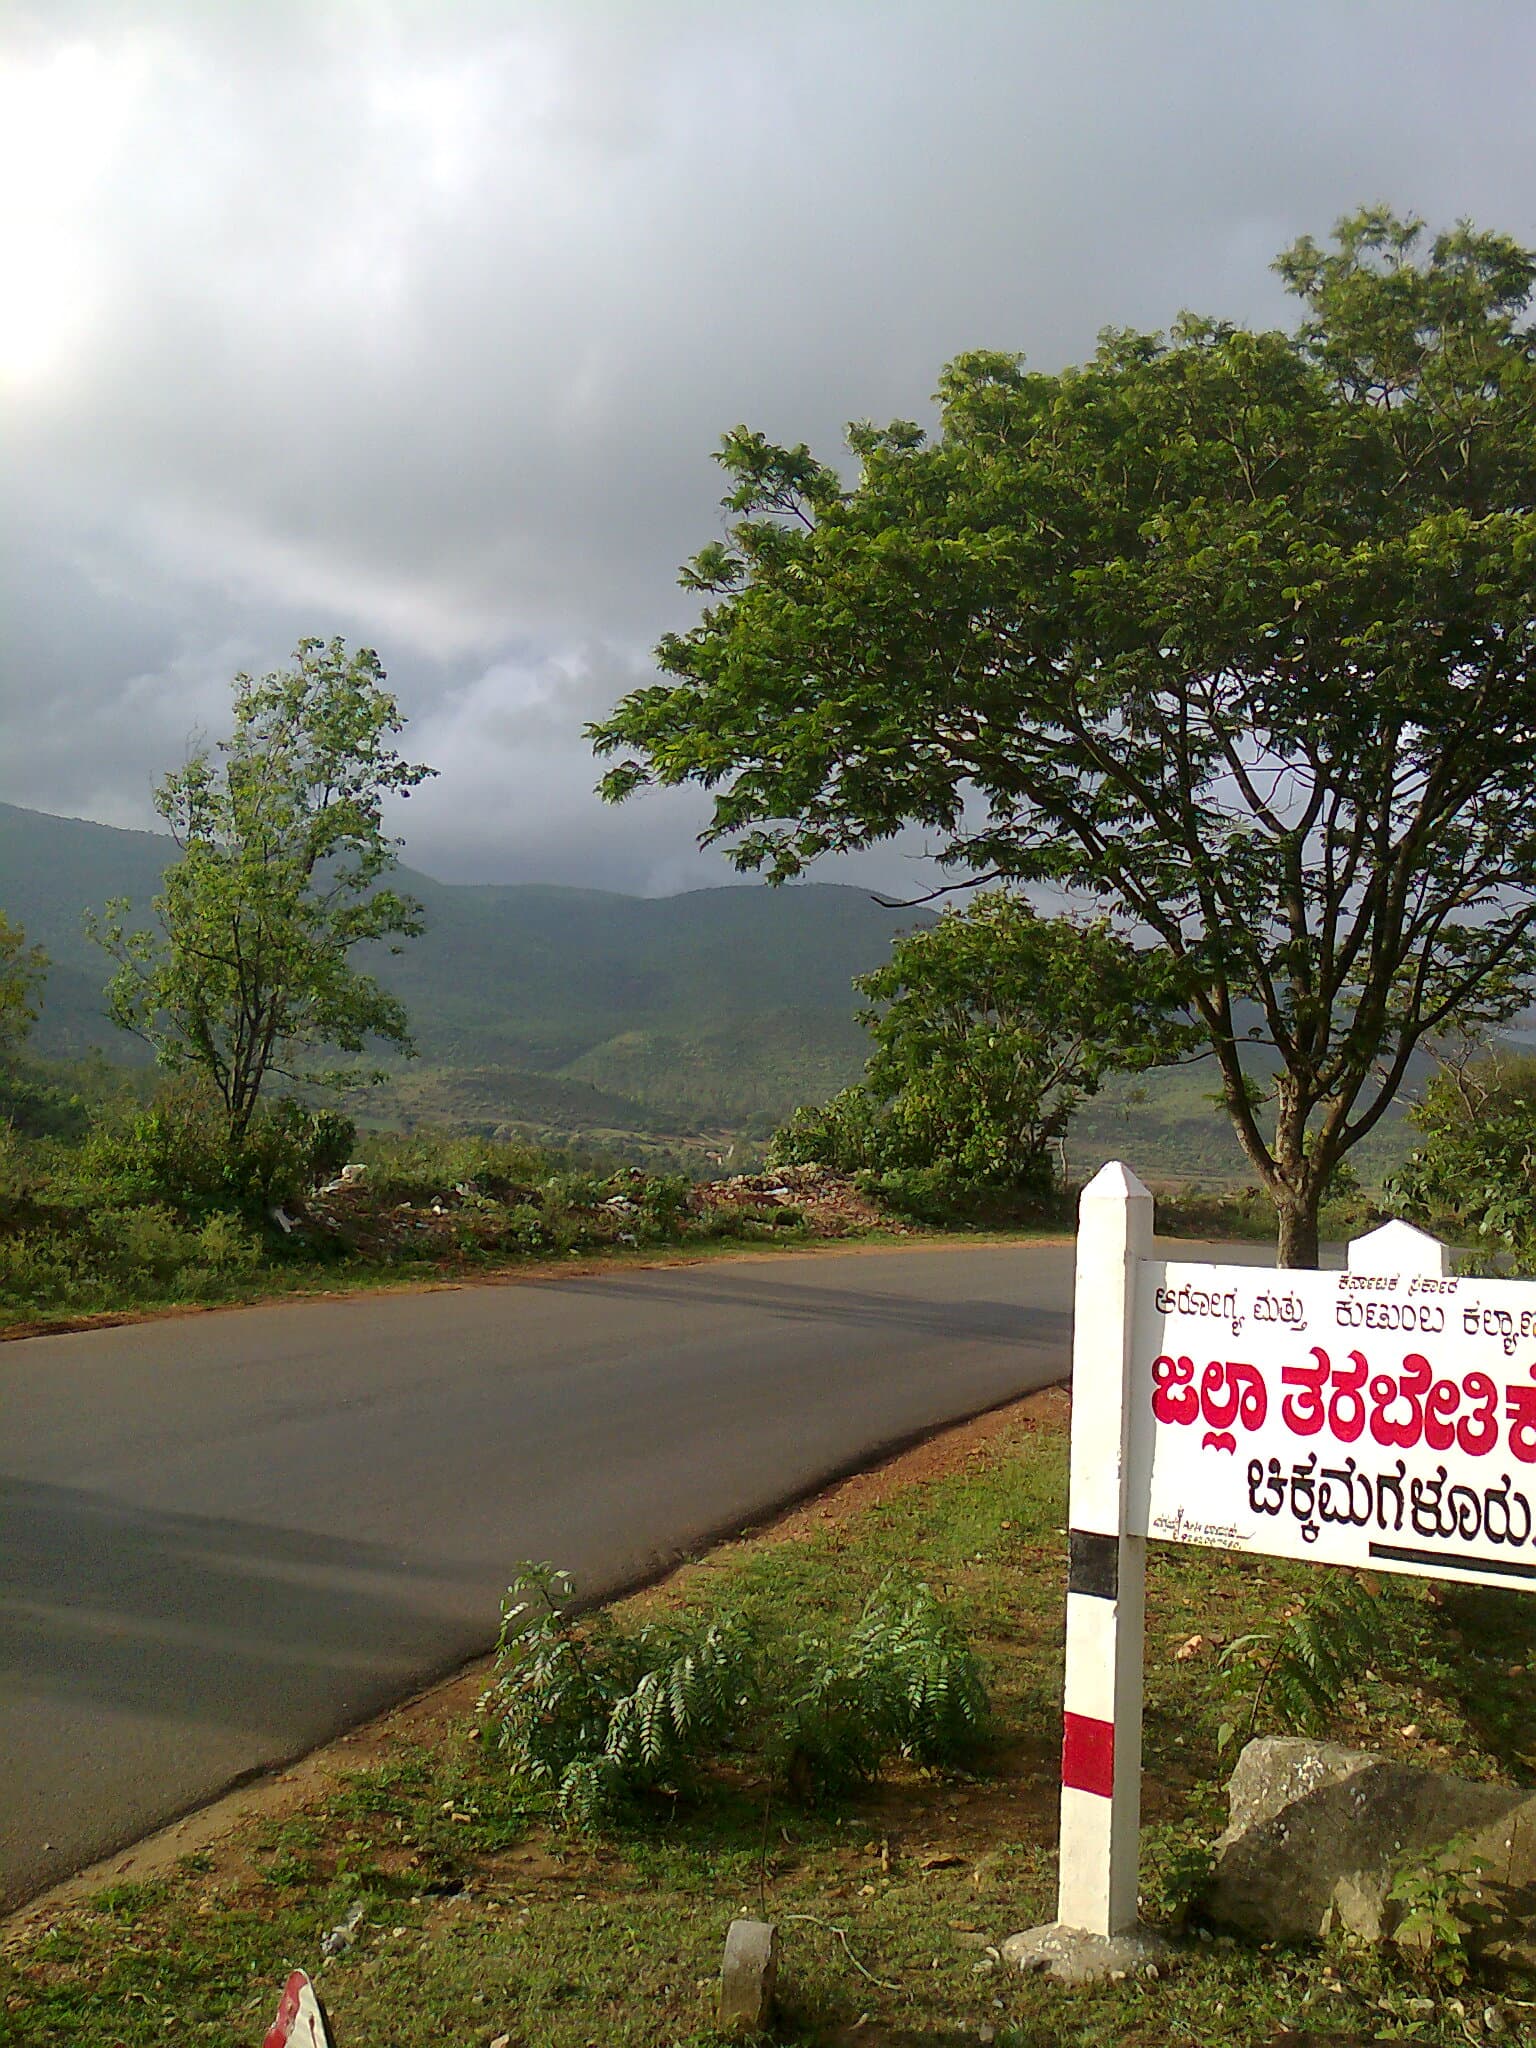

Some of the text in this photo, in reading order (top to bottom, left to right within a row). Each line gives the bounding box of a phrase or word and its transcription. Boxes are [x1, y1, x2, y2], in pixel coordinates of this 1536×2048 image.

[1155, 1283, 1246, 1337] ಆರೋಗ್ಯ
[1253, 1289, 1308, 1331] ಮತ್ತು
[1336, 1294, 1445, 1333] ಕುಟುಂಬ
[1151, 1355, 1267, 1456] ಜಿಲ್ಲಾ
